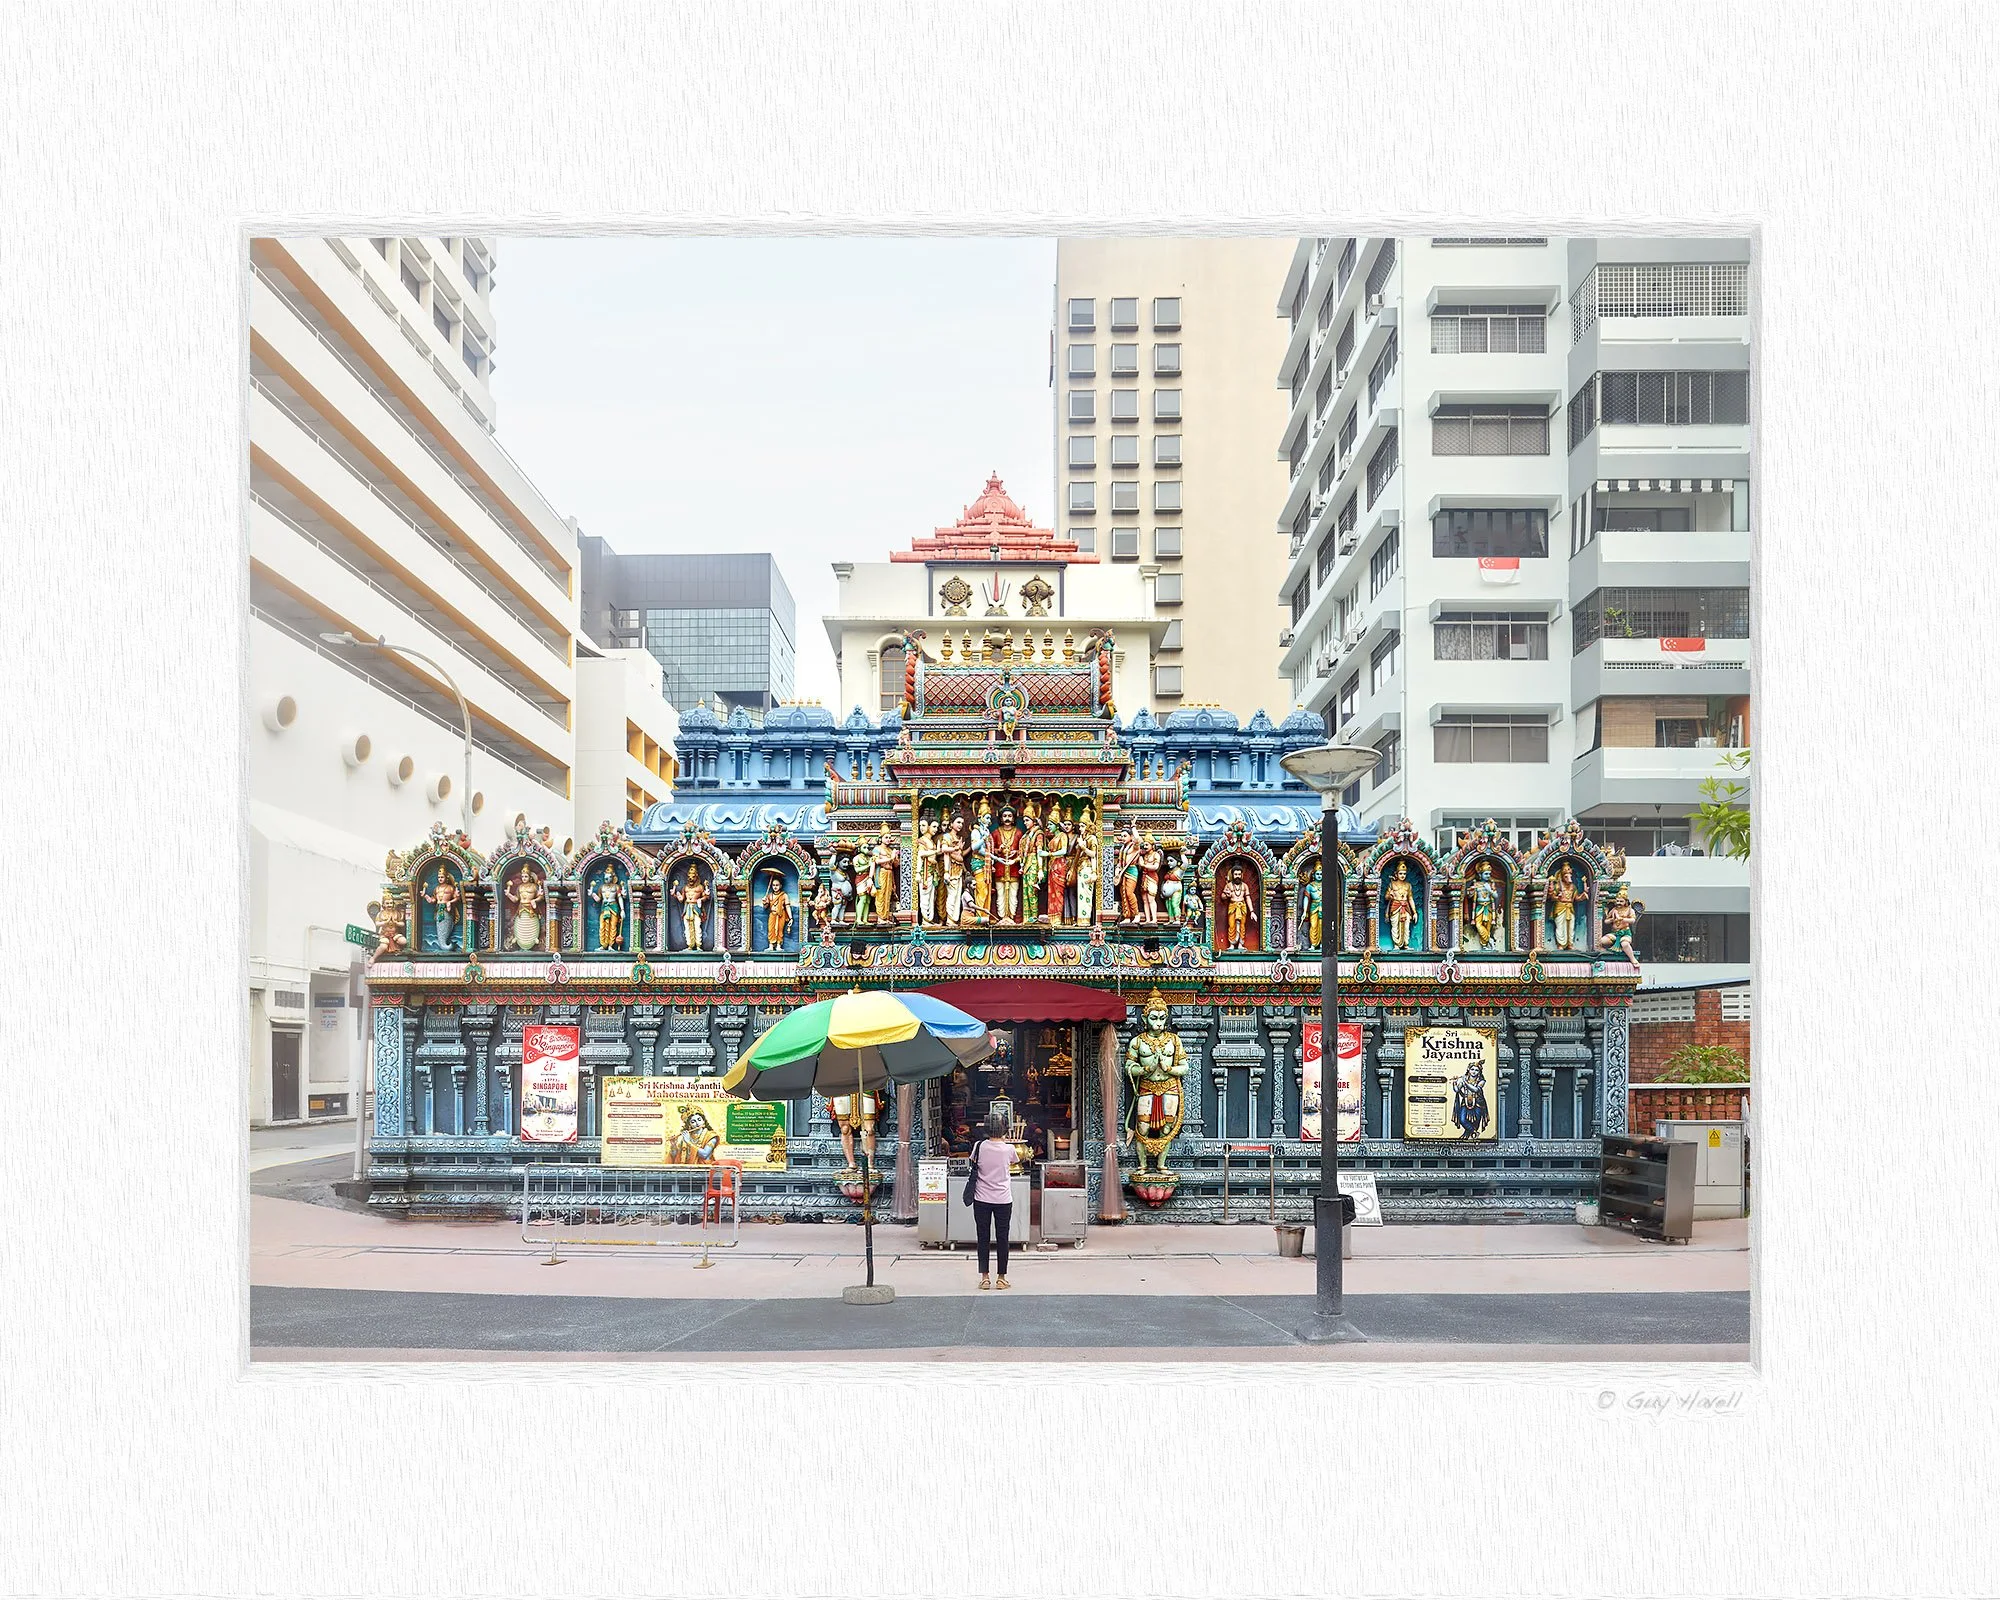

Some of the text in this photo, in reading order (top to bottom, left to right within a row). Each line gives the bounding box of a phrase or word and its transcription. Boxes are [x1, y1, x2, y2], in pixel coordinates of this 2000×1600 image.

[538, 1041, 575, 1055] Singapore
[1421, 1036, 1484, 1051] Krishna
[1422, 1049, 1481, 1061] Jayanthi
[532, 1082, 568, 1091] SINGAPORE
[638, 1081, 721, 1092] Sri Krishna Jayanthi
[646, 1090, 710, 1099] Mahotsavam
